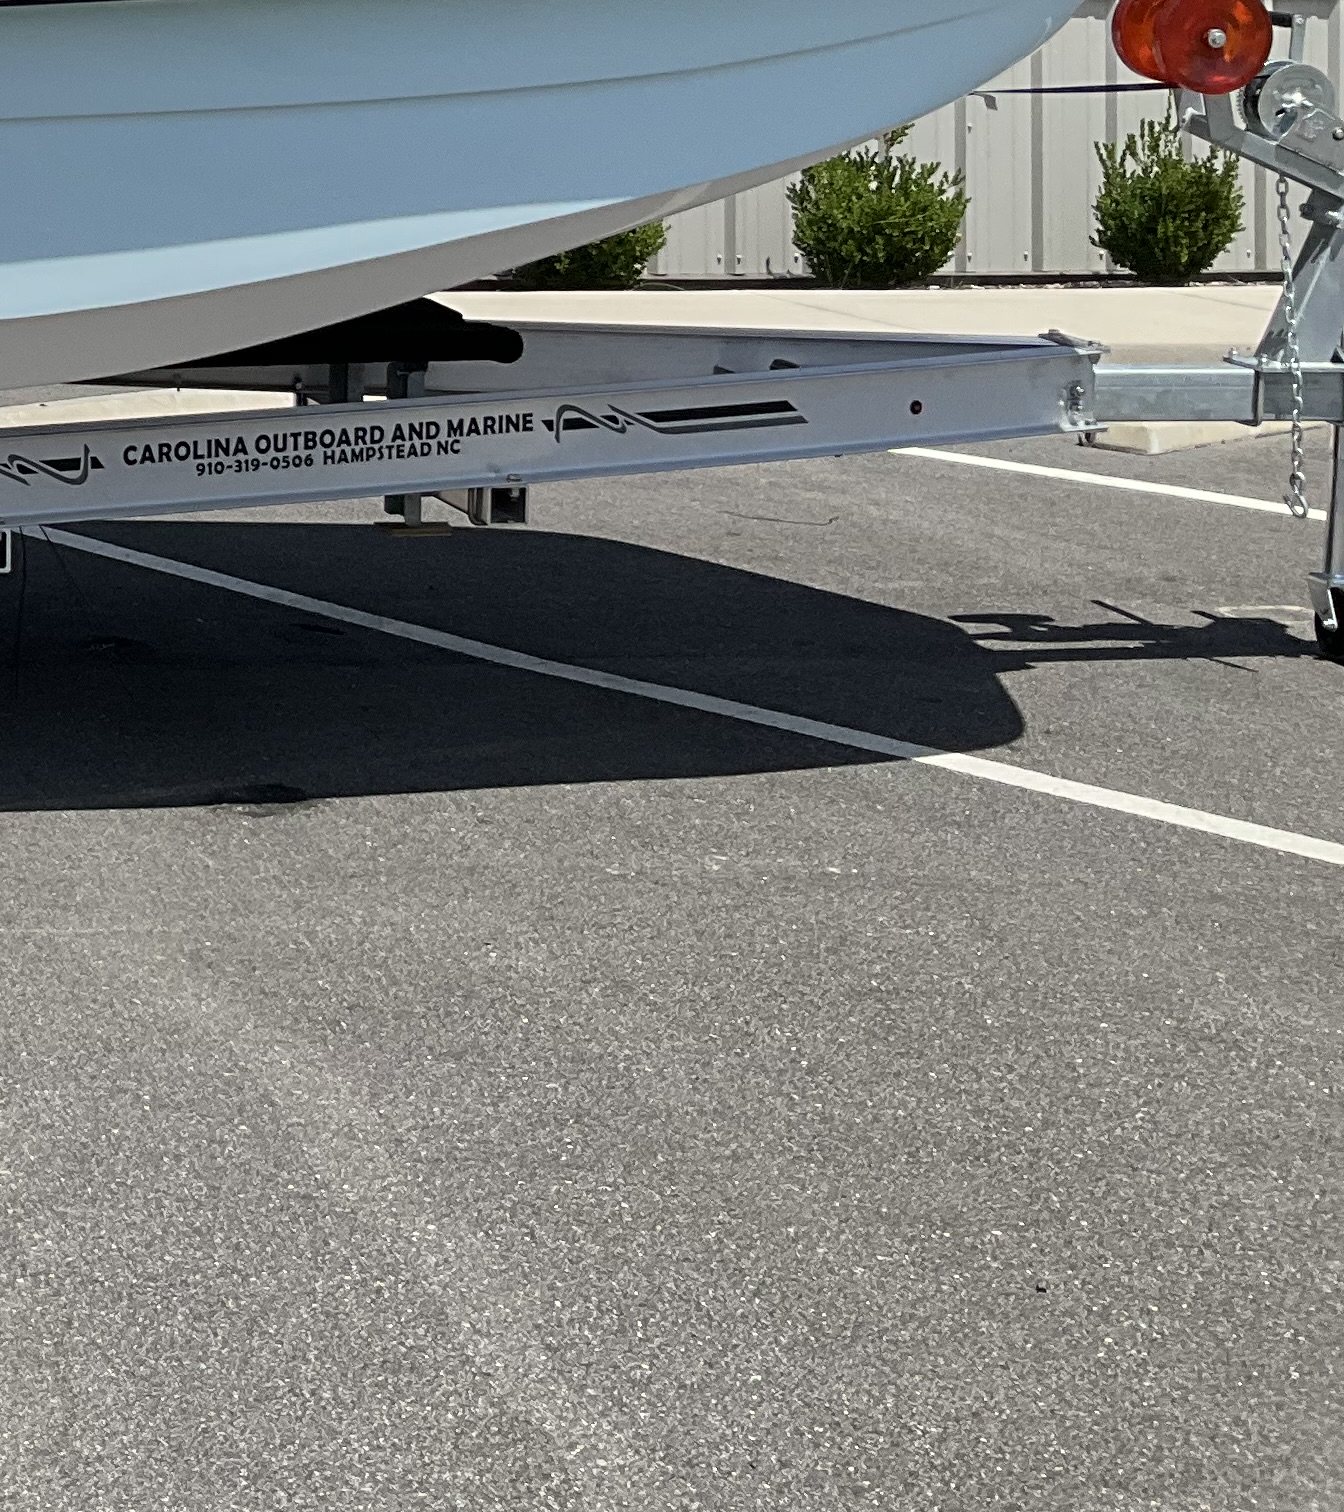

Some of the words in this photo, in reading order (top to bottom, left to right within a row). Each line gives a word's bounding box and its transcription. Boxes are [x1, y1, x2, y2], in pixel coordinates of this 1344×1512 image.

[122, 436, 249, 466] CAROLINA
[254, 425, 385, 455] OUTBOARD
[391, 421, 441, 442] AND
[447, 413, 534, 438] MARINE
[196, 453, 314, 476] 910-319-0506
[323, 441, 432, 466] HAMPSTEAD
[437, 439, 461, 456] NC
